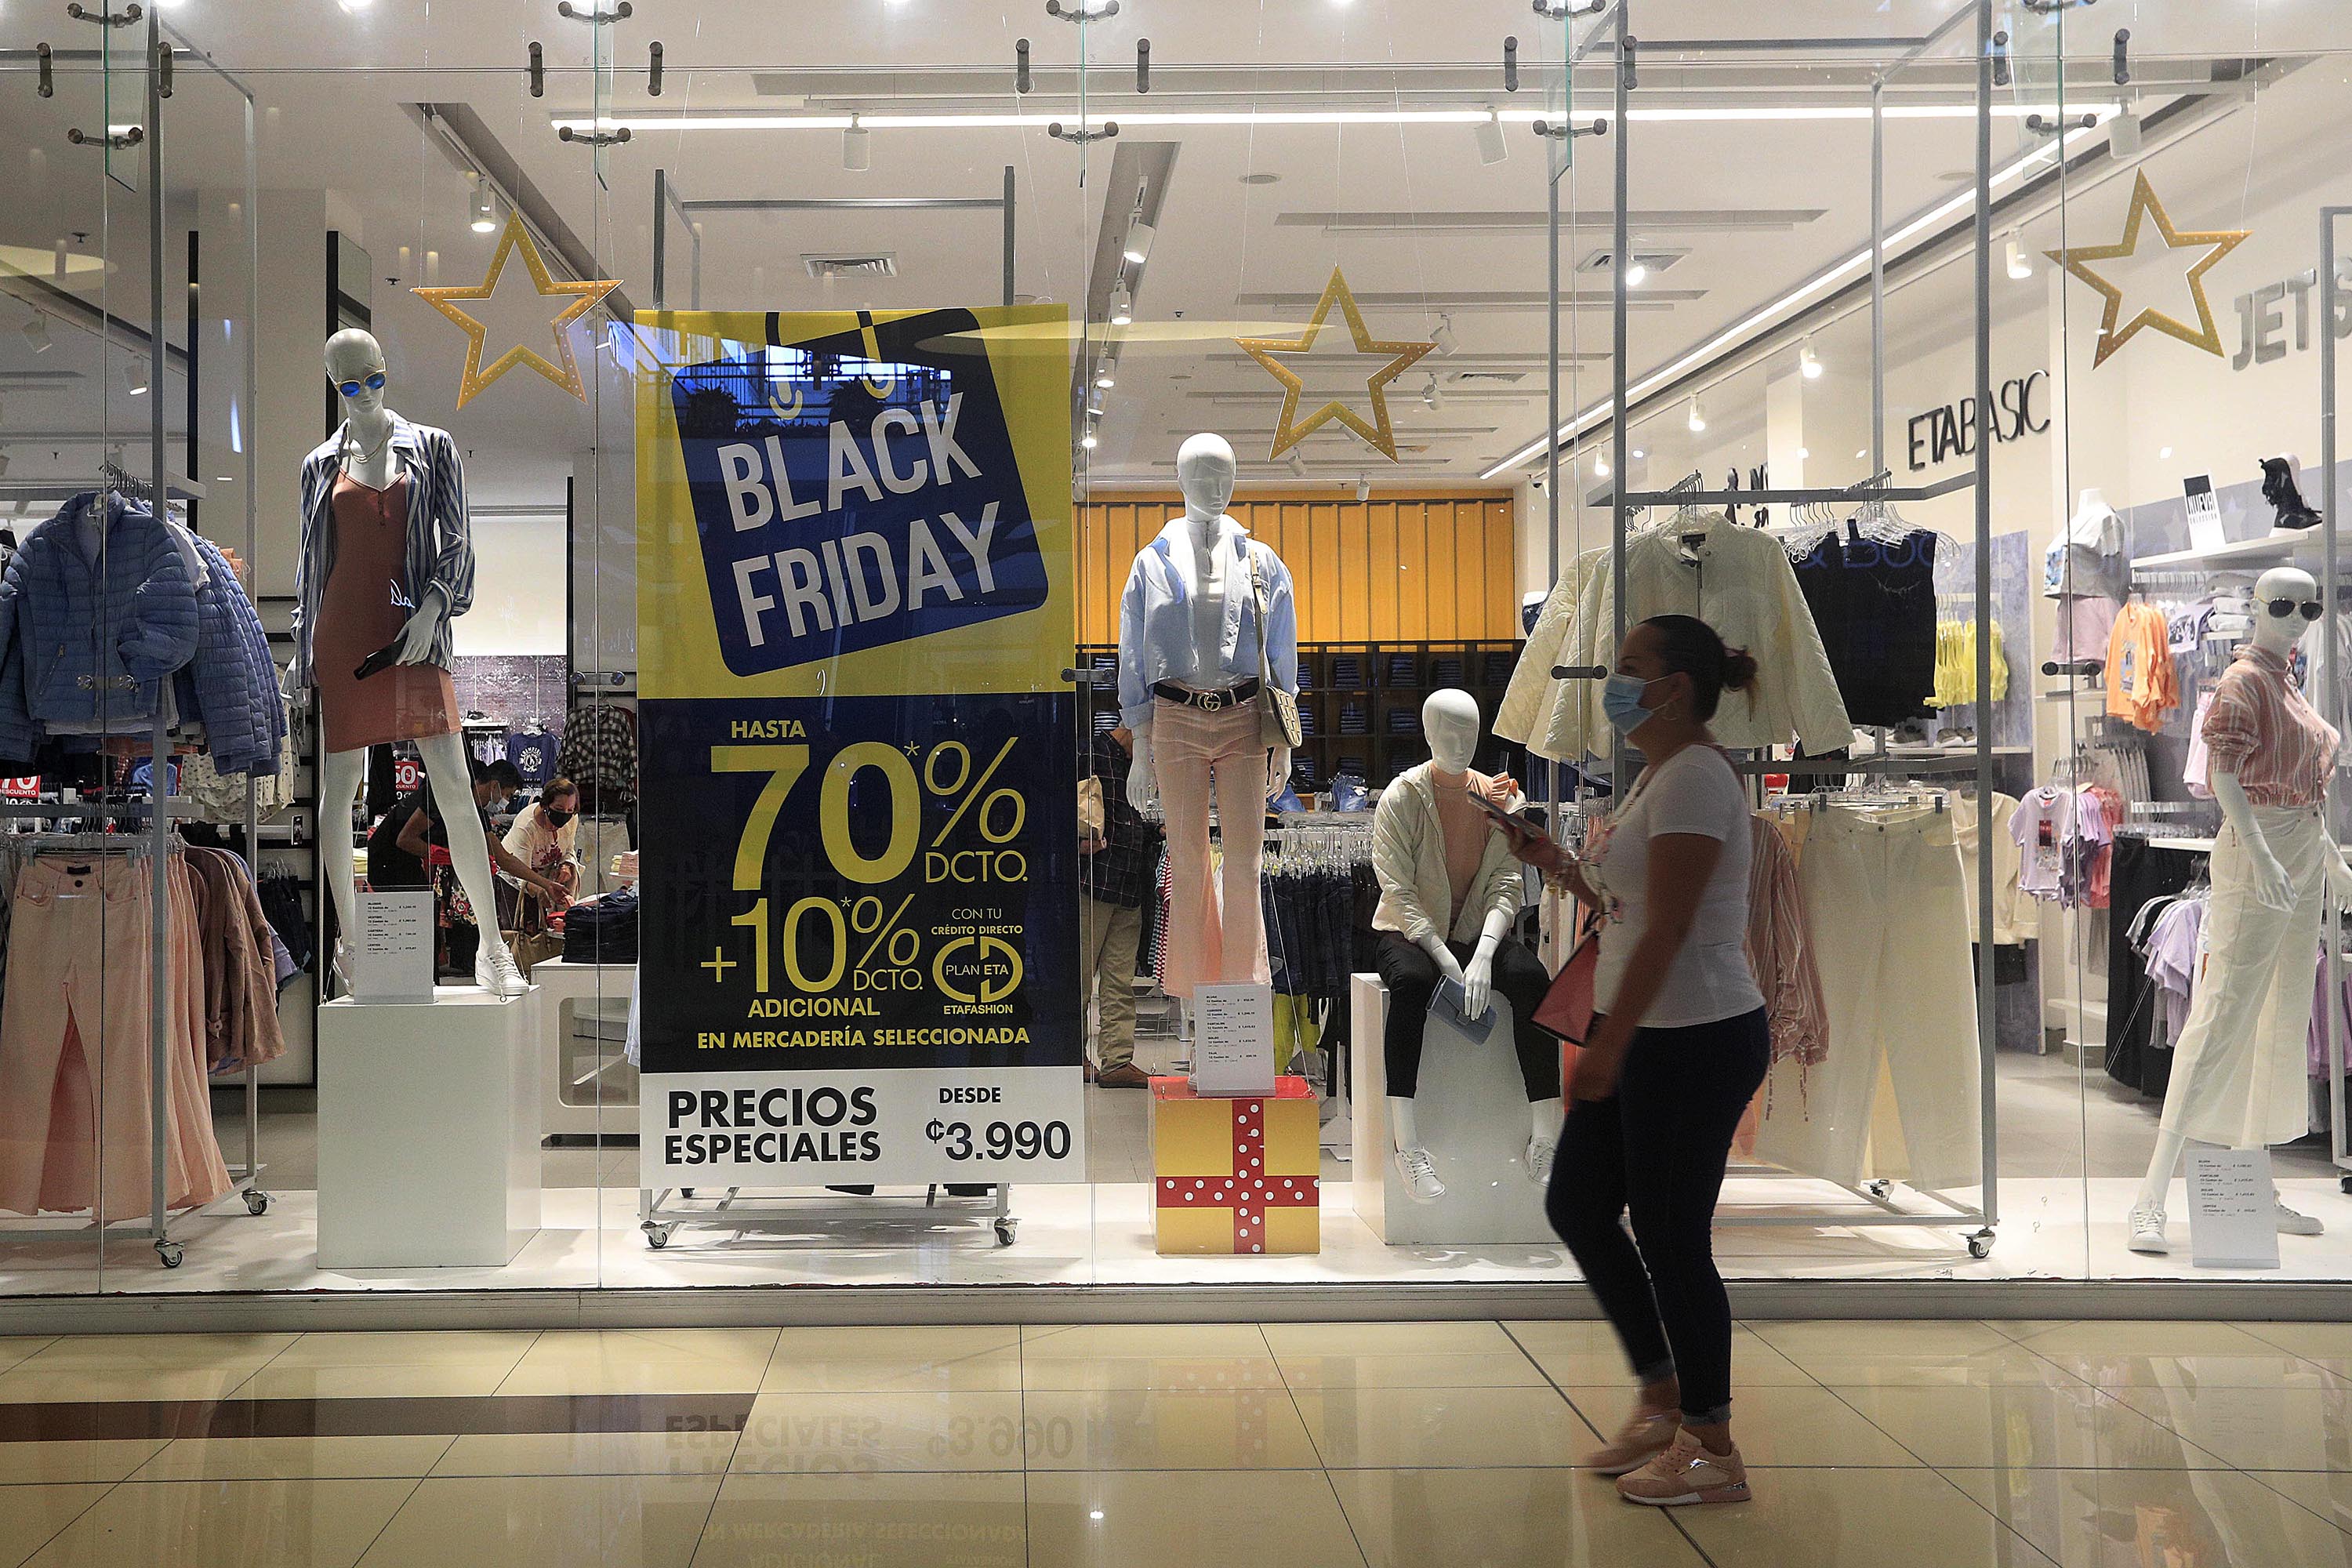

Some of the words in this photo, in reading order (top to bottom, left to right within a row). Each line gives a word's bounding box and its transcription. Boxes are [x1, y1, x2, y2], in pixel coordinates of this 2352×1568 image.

[2233, 267, 2317, 372] JET
[717, 391, 983, 532] BLACK
[731, 500, 1001, 648] FRIDAY
[731, 720, 807, 739] HASTA
[925, 849, 1029, 884] DCTO.
[952, 908, 982, 920] CON
[986, 908, 1002, 920] TU
[931, 924, 976, 935] CRÉDITO
[978, 925, 1023, 935] DIRECTO
[853, 968, 924, 993] DCTO.
[946, 964, 980, 976] PLAN
[983, 964, 1009, 976] ETA
[747, 997, 880, 1018] ADICIONAL
[943, 1004, 1014, 1015] ETAFASHION
[697, 1033, 729, 1050] EN
[732, 1025, 866, 1049] MERCADERÍA
[873, 1027, 1031, 1047] SELECCIONADA
[668, 1086, 878, 1130] PRECIOS
[939, 1087, 1002, 1104] DESDE
[664, 1131, 882, 1166] ESPECIALES
